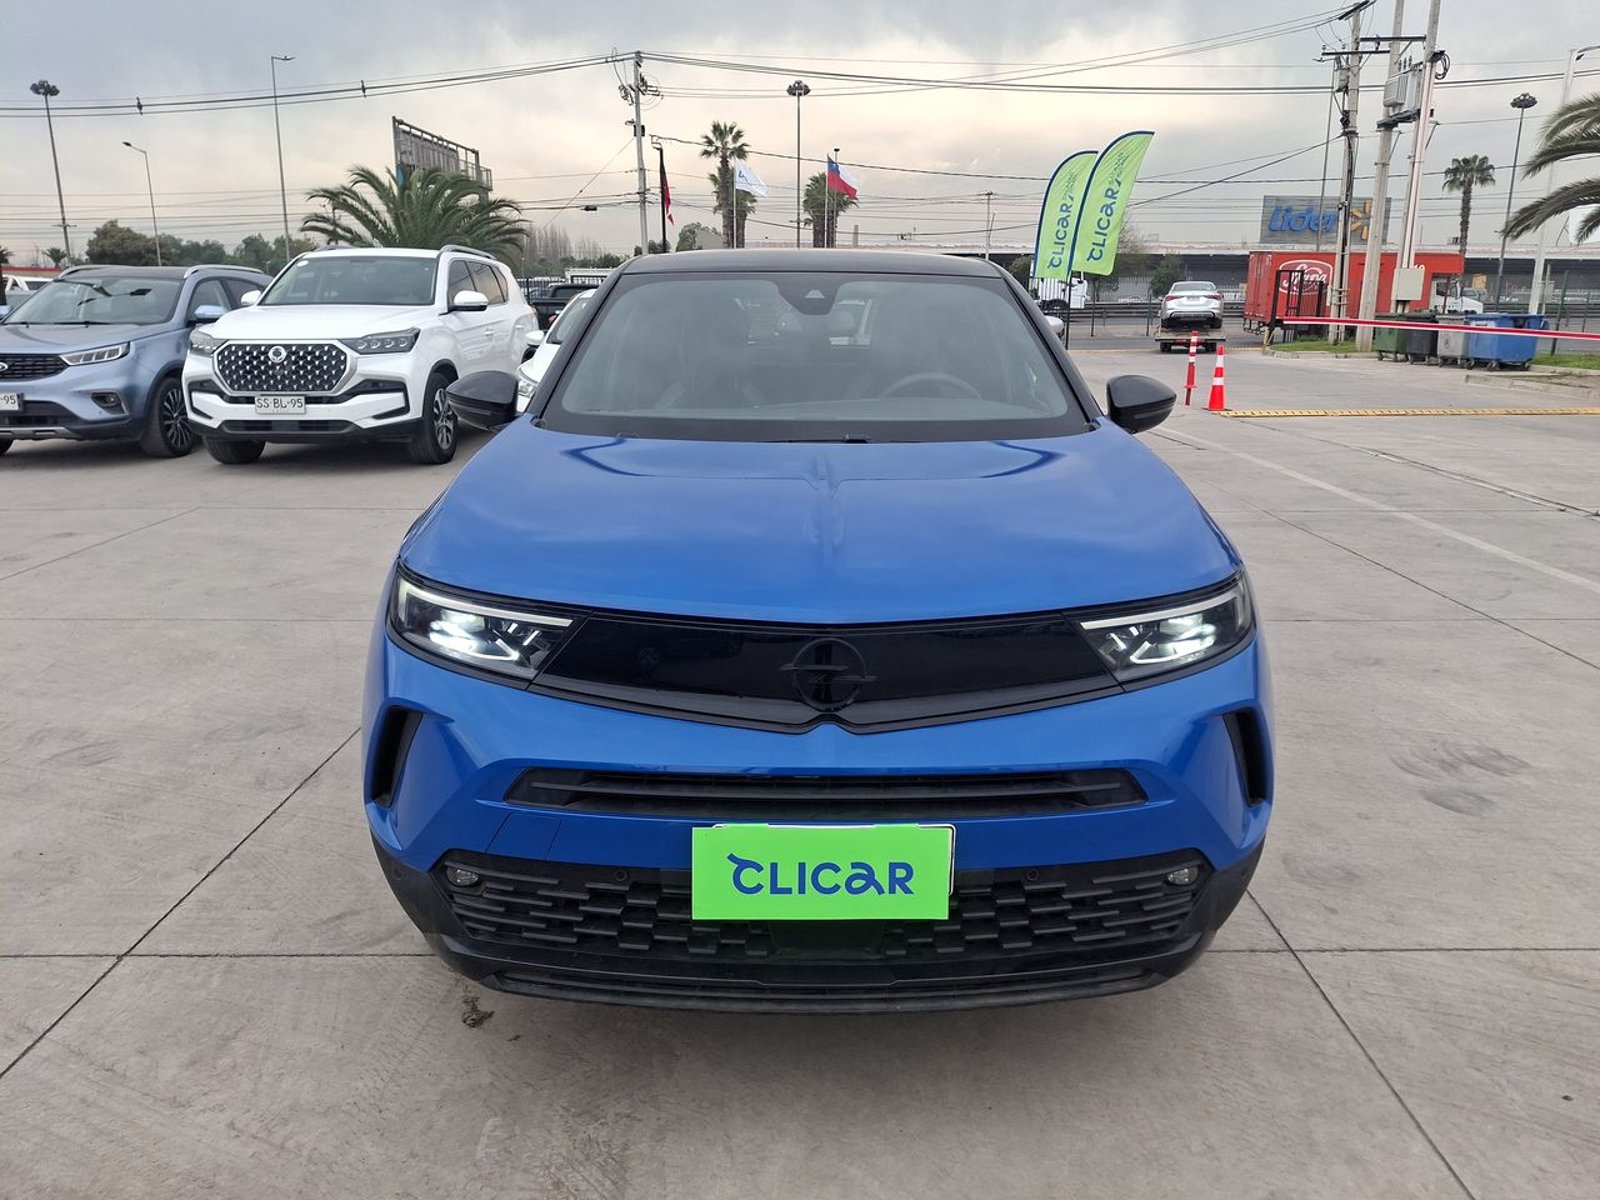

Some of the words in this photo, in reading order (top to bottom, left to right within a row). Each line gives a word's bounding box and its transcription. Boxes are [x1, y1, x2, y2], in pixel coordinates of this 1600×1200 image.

[1047, 203, 1072, 269] CLICAR
[1087, 188, 1120, 261] CLICAR
[726, 853, 915, 895] CLICAR
